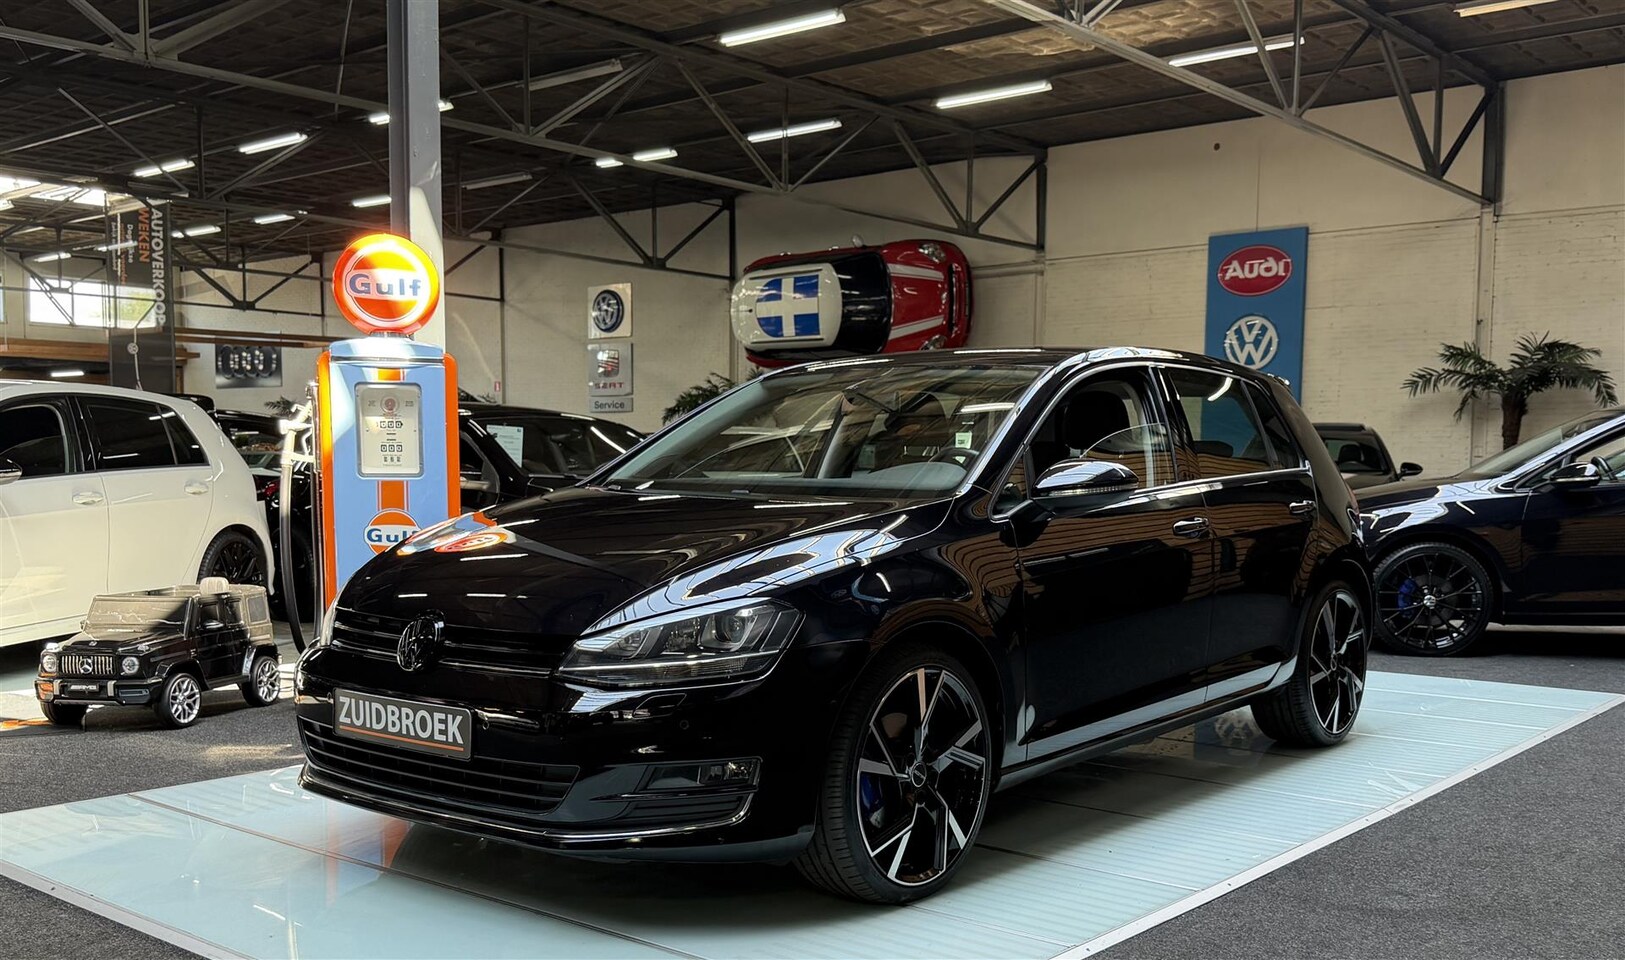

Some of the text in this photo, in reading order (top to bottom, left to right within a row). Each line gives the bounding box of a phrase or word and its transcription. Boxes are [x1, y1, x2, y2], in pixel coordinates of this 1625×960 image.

[138, 207, 151, 263] WEKEN
[150, 208, 167, 327] AUTOVERKOOP
[349, 273, 422, 297] Gulf
[594, 400, 625, 410] Service
[366, 528, 420, 543] Gul
[339, 696, 464, 744] ZUIDBROEK
